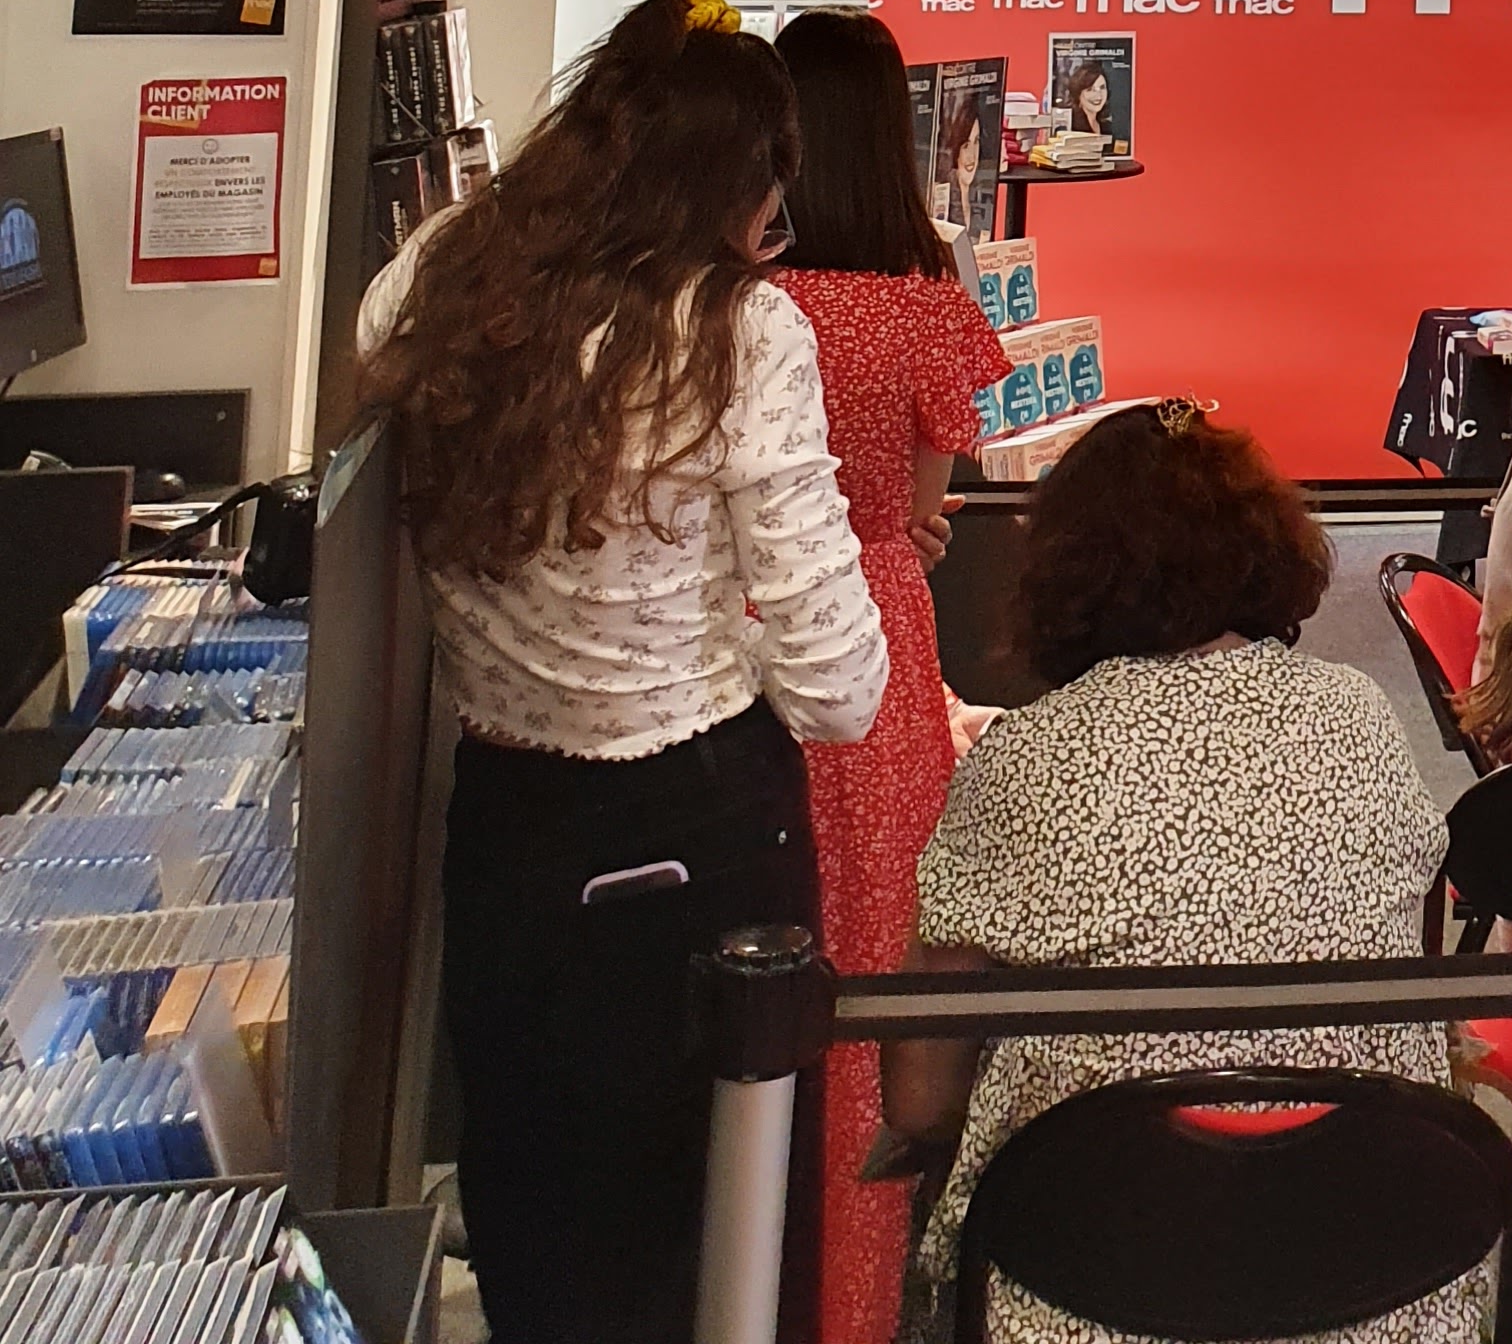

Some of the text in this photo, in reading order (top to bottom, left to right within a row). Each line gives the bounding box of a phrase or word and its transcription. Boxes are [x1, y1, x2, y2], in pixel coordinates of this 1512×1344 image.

[148, 84, 280, 103] INFORMATION
[147, 104, 211, 120] CLIENT
[218, 188, 263, 198] MAGASIN
